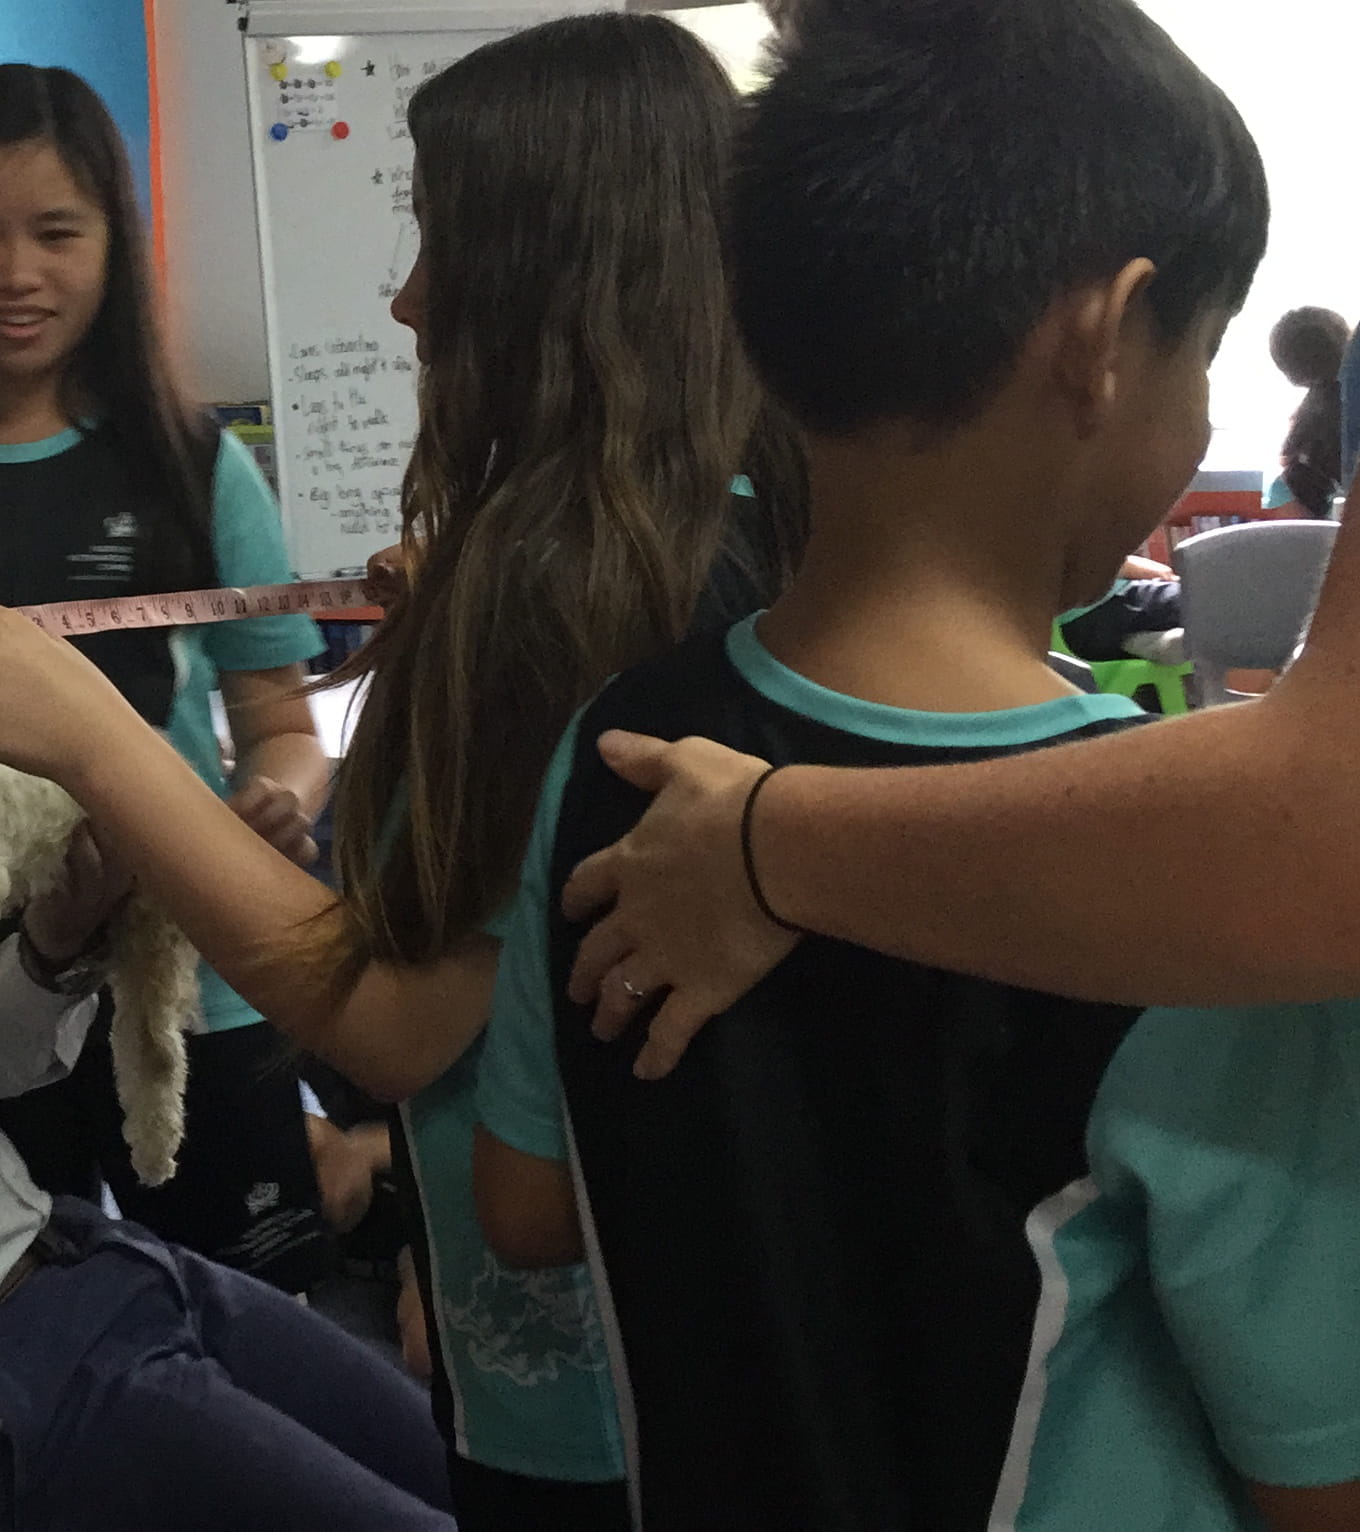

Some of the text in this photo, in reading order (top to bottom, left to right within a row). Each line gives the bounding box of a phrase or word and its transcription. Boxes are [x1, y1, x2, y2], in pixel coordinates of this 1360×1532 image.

[85, 612, 96, 627] 5
[110, 610, 122, 625] 6
[135, 606, 147, 622] 7
[184, 603, 194, 618] 9
[210, 600, 225, 616] 10
[234, 599, 248, 614] 11
